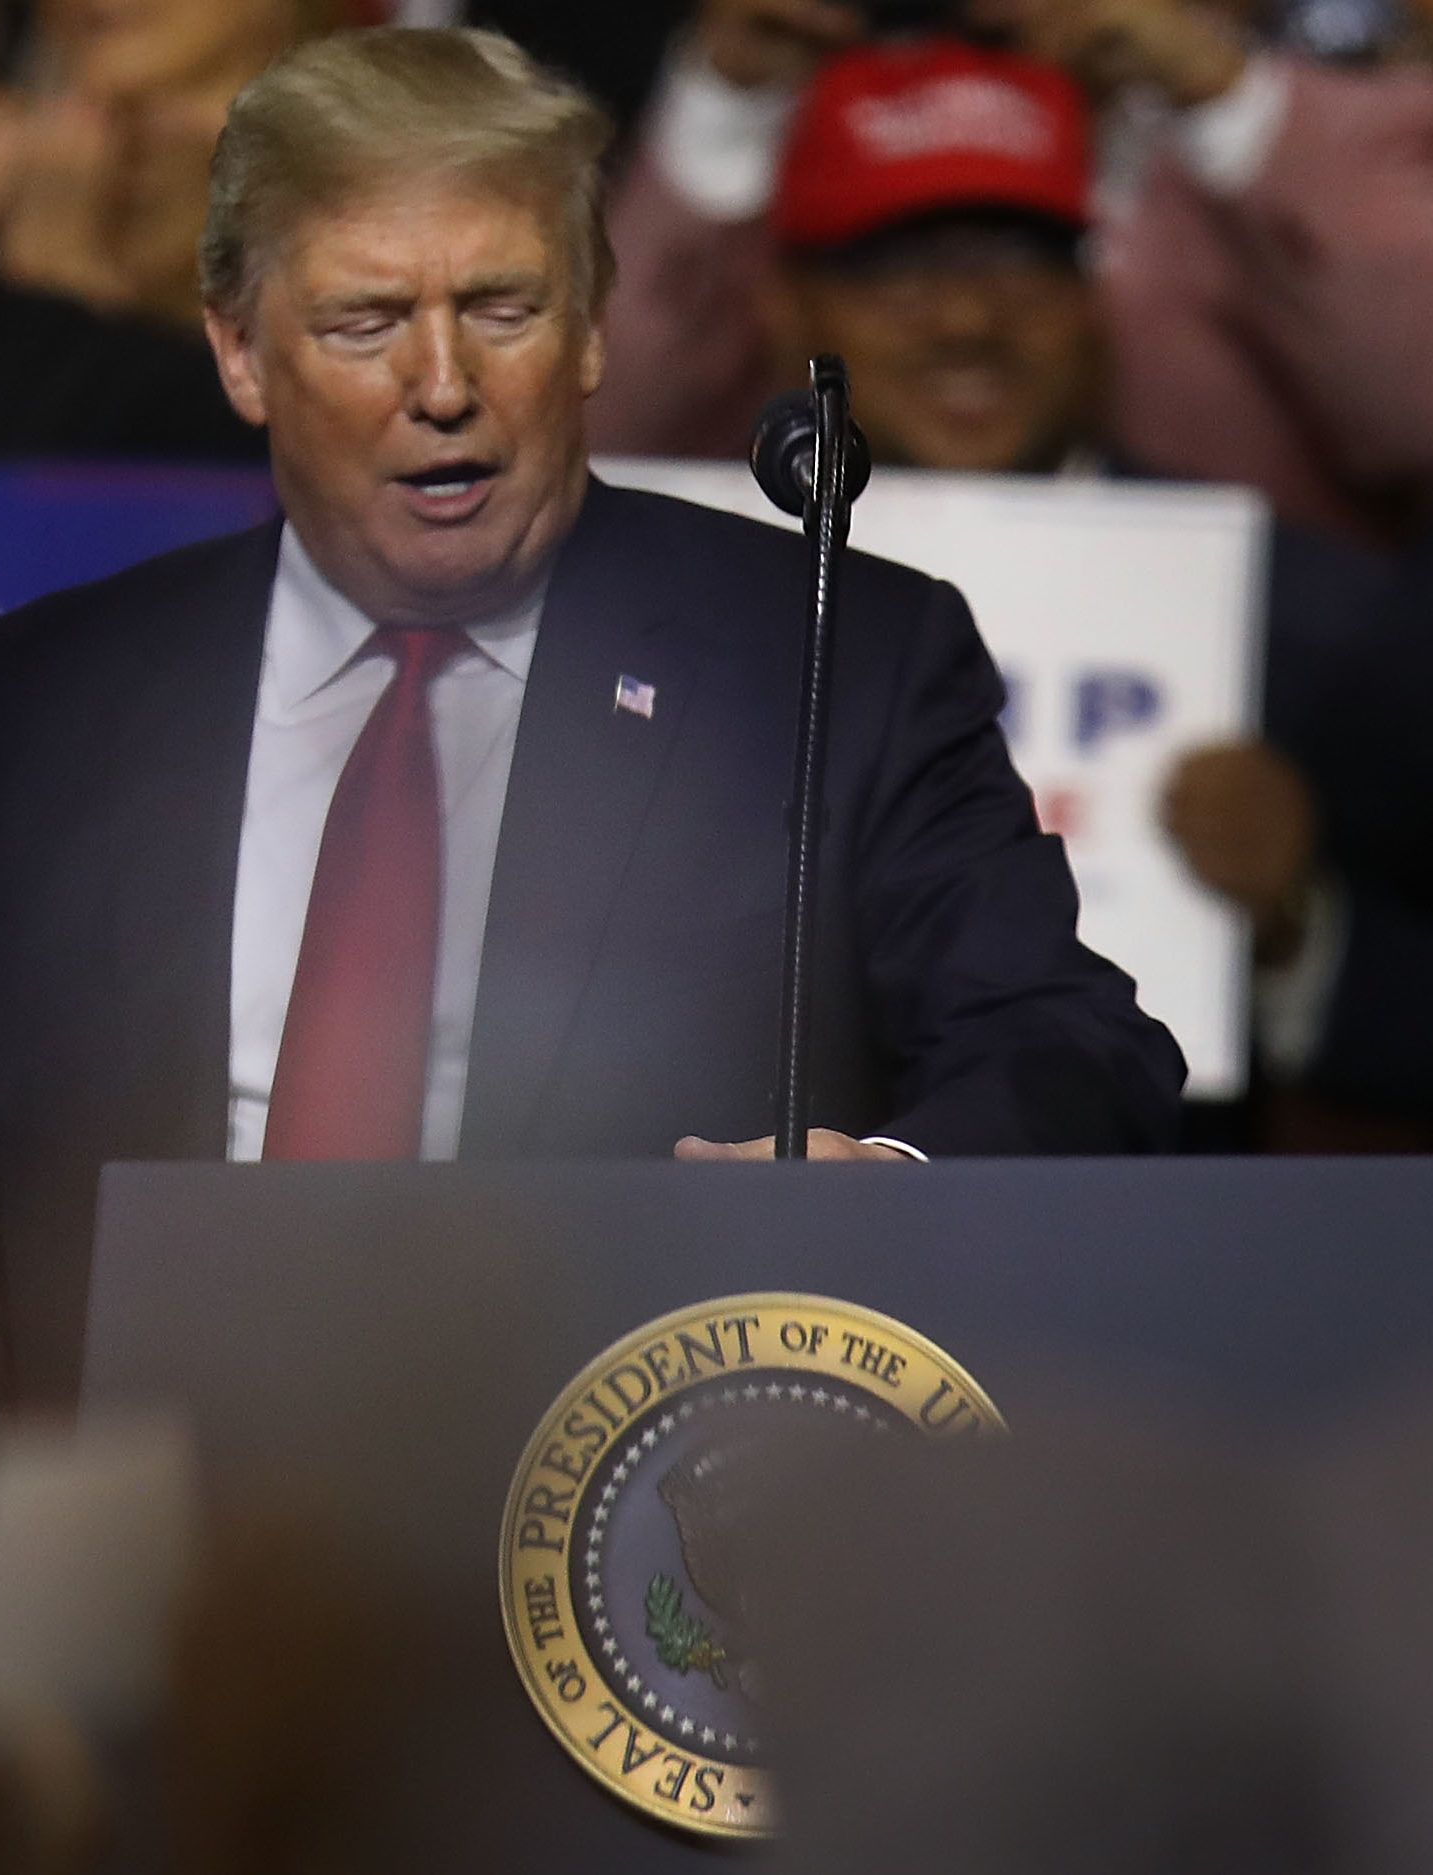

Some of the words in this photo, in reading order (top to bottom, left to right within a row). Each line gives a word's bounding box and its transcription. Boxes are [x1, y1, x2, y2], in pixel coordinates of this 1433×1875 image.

[779, 1319, 829, 1356] OF
[839, 1331, 908, 1388] THE
[518, 1313, 760, 1555] PRESIDENT
[524, 1574, 565, 1651] THE
[545, 1658, 587, 1702] OF
[586, 1700, 725, 1812] SEAL
